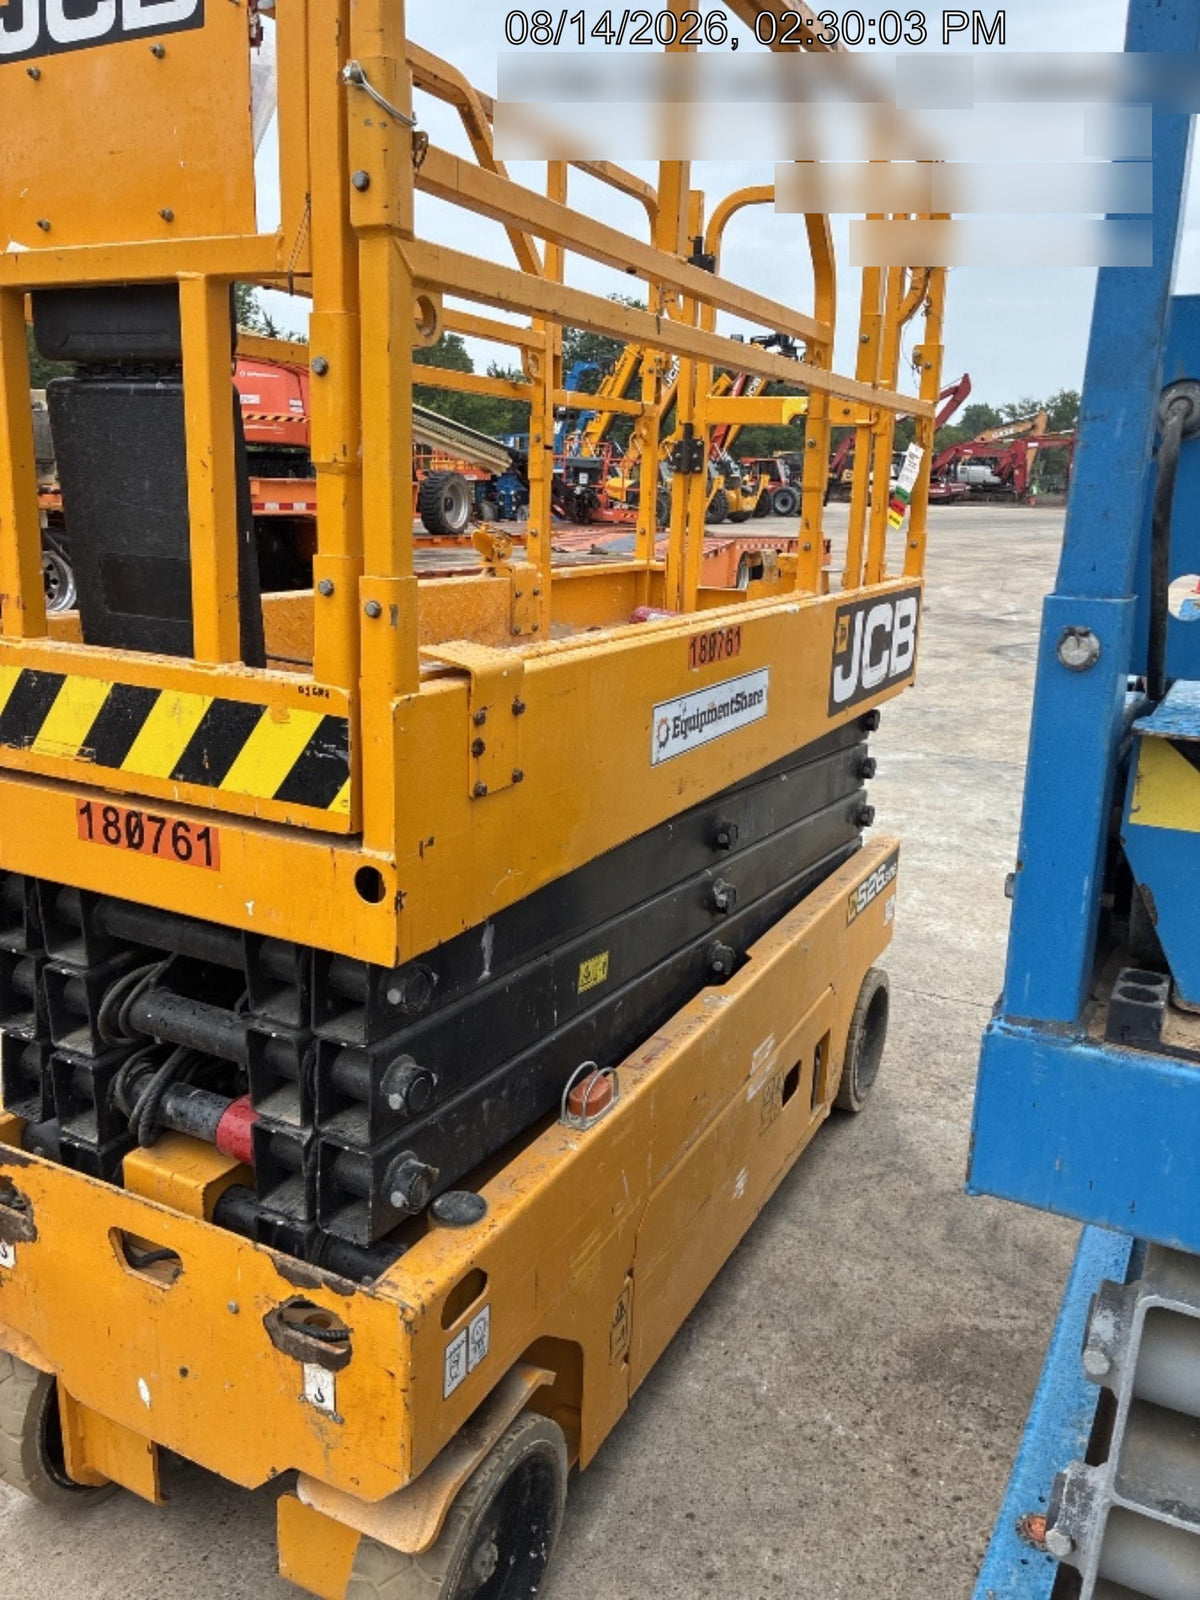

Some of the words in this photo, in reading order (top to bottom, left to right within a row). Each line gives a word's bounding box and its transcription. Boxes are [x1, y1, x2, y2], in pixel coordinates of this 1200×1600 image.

[690, 626, 741, 667] 180761
[834, 597, 918, 703] JCB
[672, 688, 764, 740] EquipmentShare
[79, 801, 212, 867] 180761
